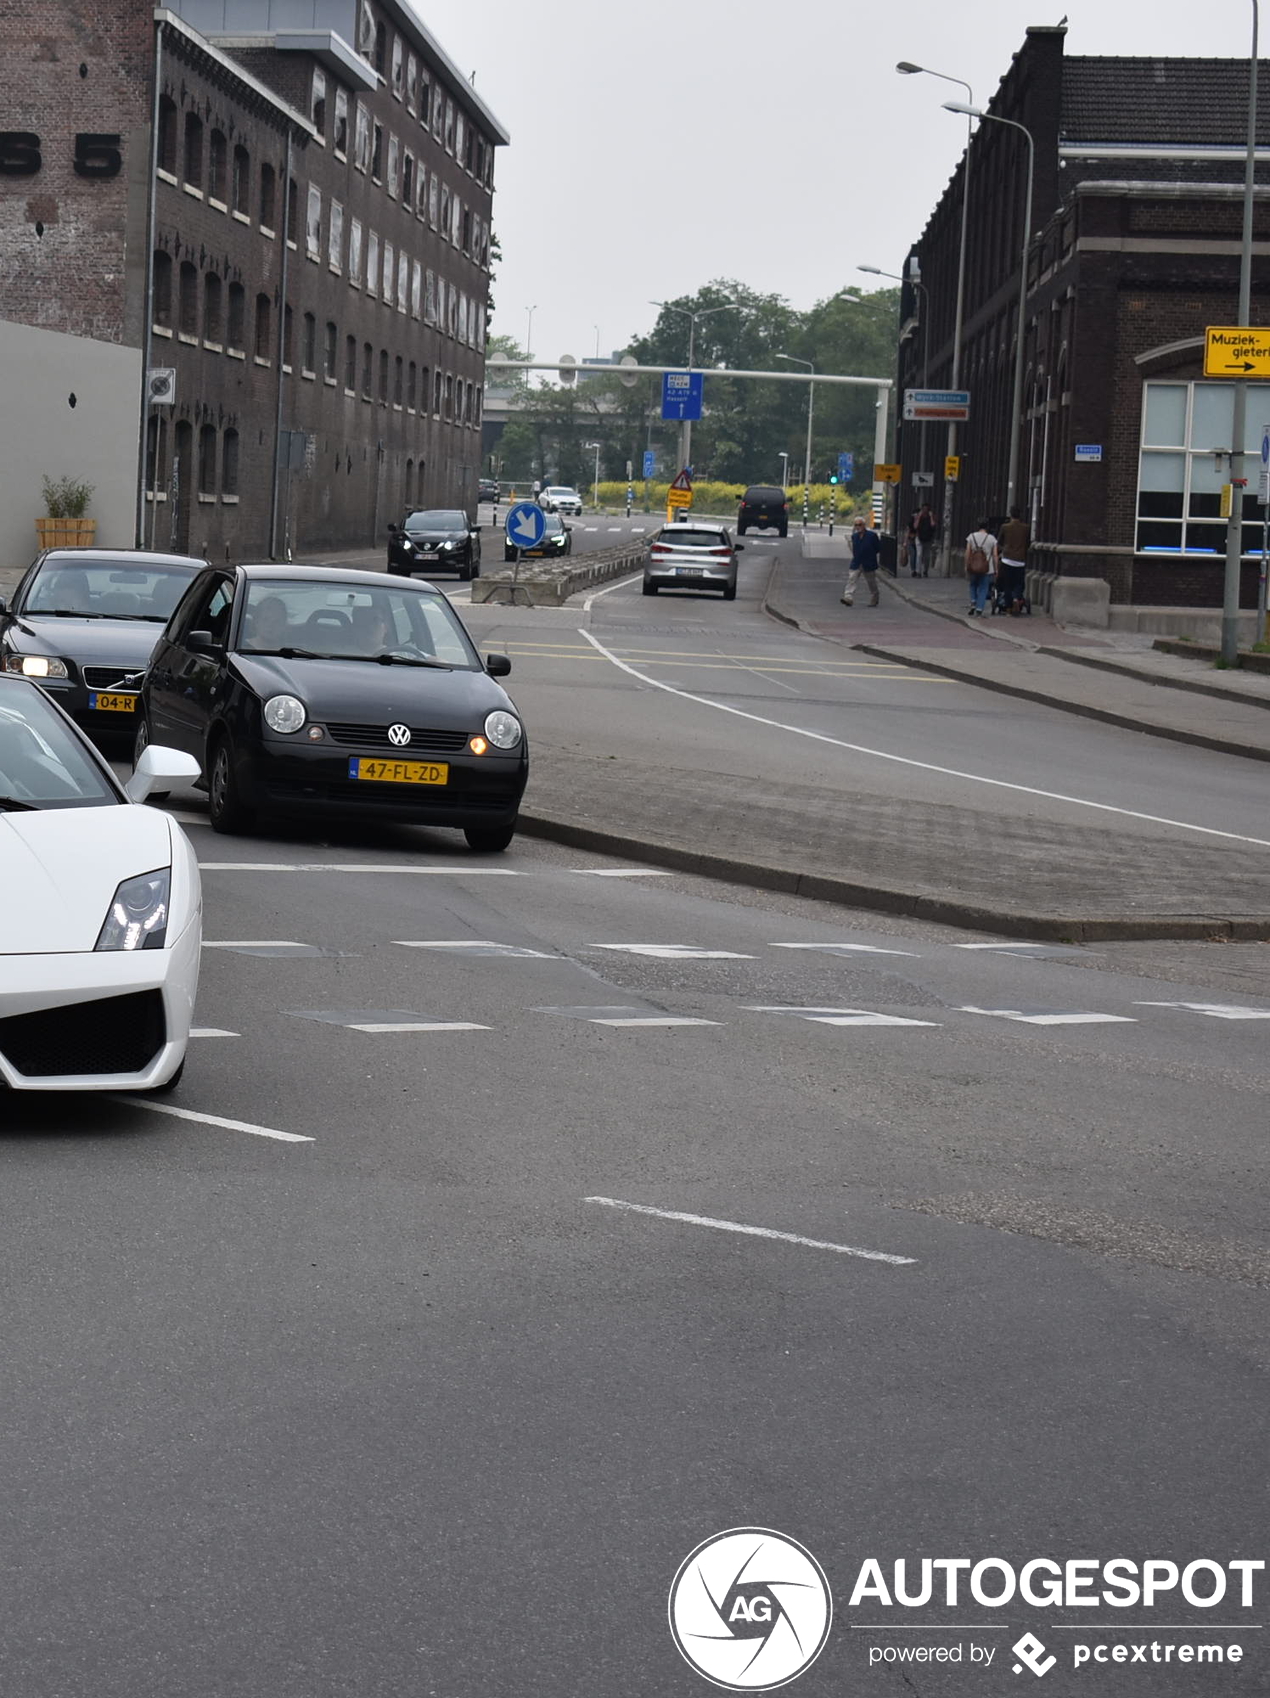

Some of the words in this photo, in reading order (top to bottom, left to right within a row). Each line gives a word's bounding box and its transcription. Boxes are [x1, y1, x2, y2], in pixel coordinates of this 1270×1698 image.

[73, 133, 122, 178] 5
[1211, 334, 1260, 345] Muziek-
[100, 695, 133, 710] 04-R
[365, 762, 441, 782] 47-FL-ZD
